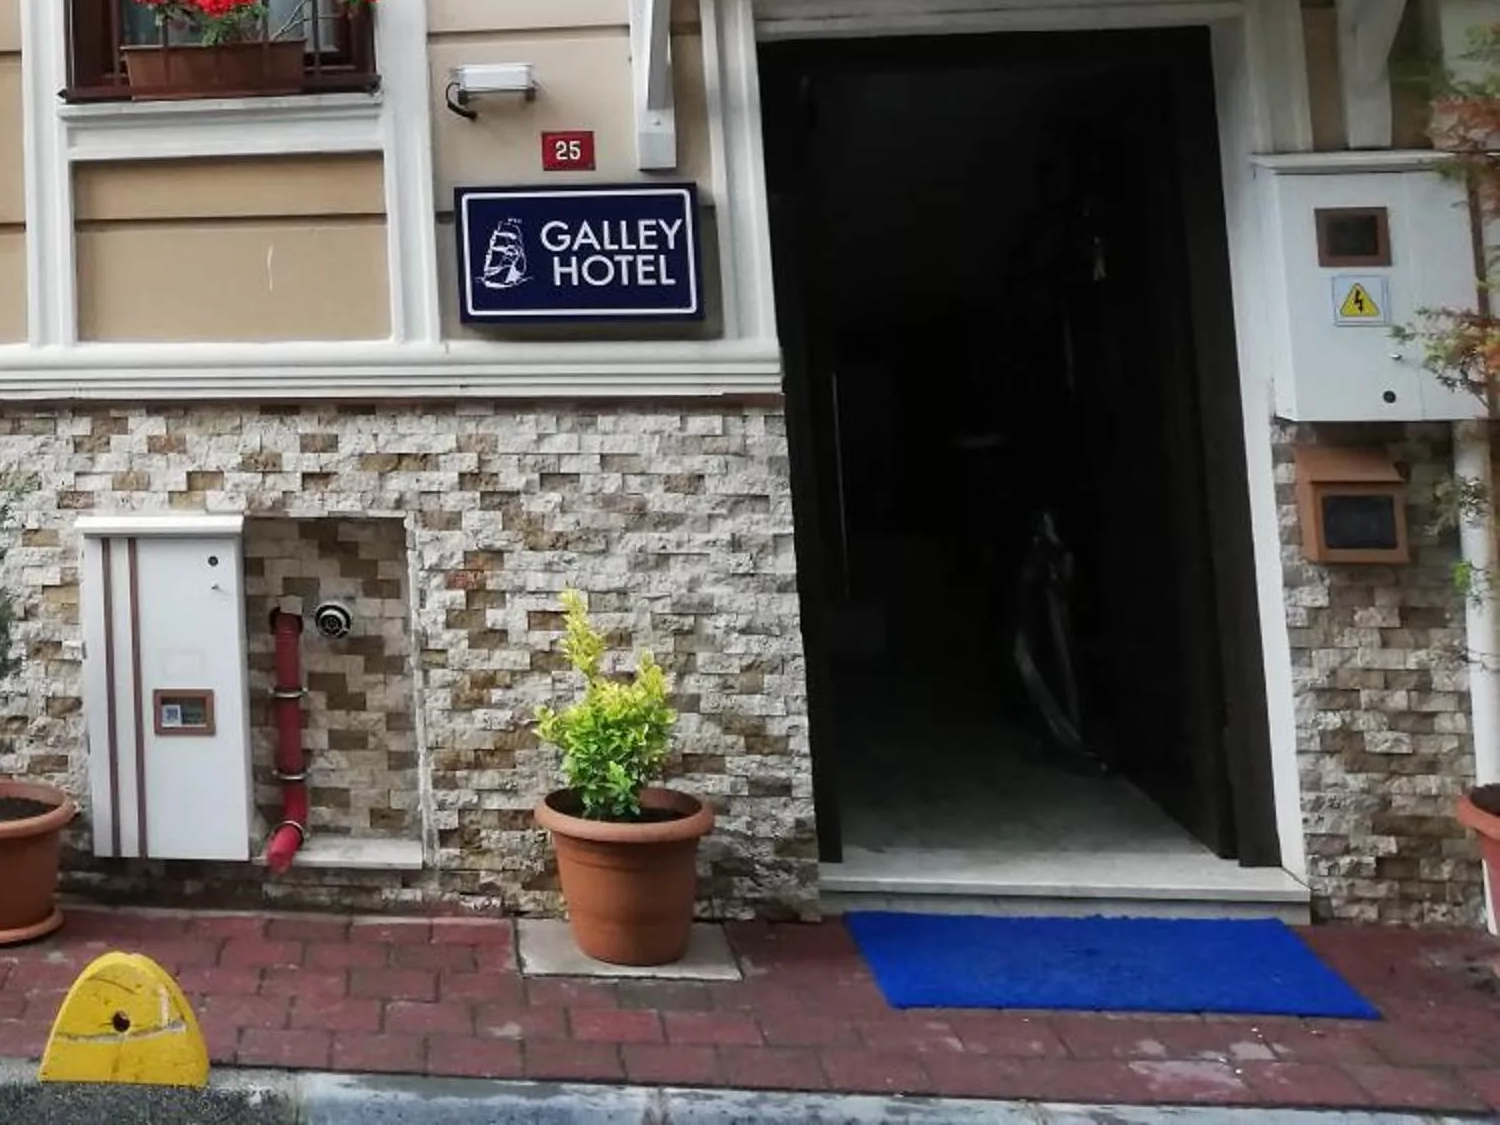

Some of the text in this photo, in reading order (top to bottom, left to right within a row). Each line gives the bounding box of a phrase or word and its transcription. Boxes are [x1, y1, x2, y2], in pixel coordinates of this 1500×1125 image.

[554, 140, 581, 161] 25
[540, 219, 683, 252] GALLEY
[553, 255, 677, 286] HOTEL
